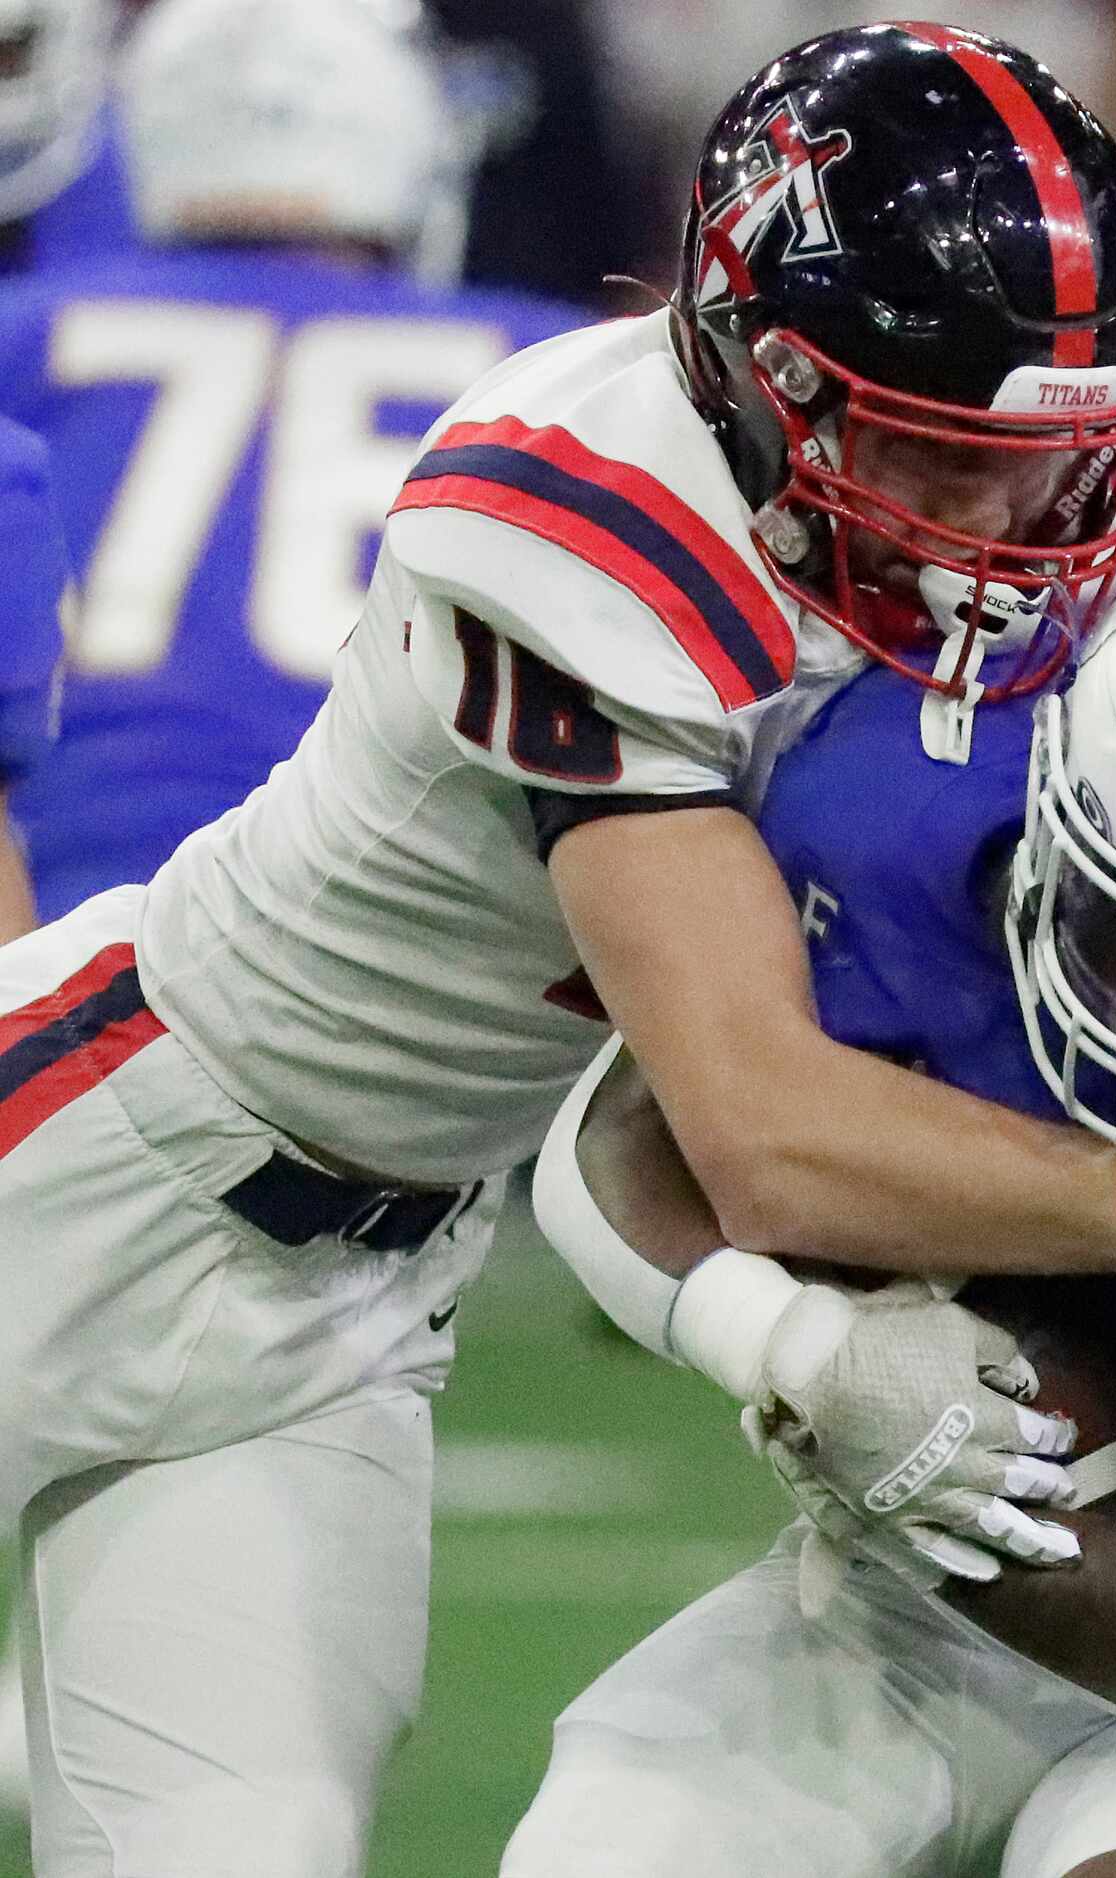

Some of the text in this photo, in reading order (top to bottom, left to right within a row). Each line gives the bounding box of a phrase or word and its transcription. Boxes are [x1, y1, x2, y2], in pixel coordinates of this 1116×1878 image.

[1038, 383, 1110, 406] TITANS
[964, 584, 1016, 614] SOCK
[875, 1414, 968, 1507] BATTLE
